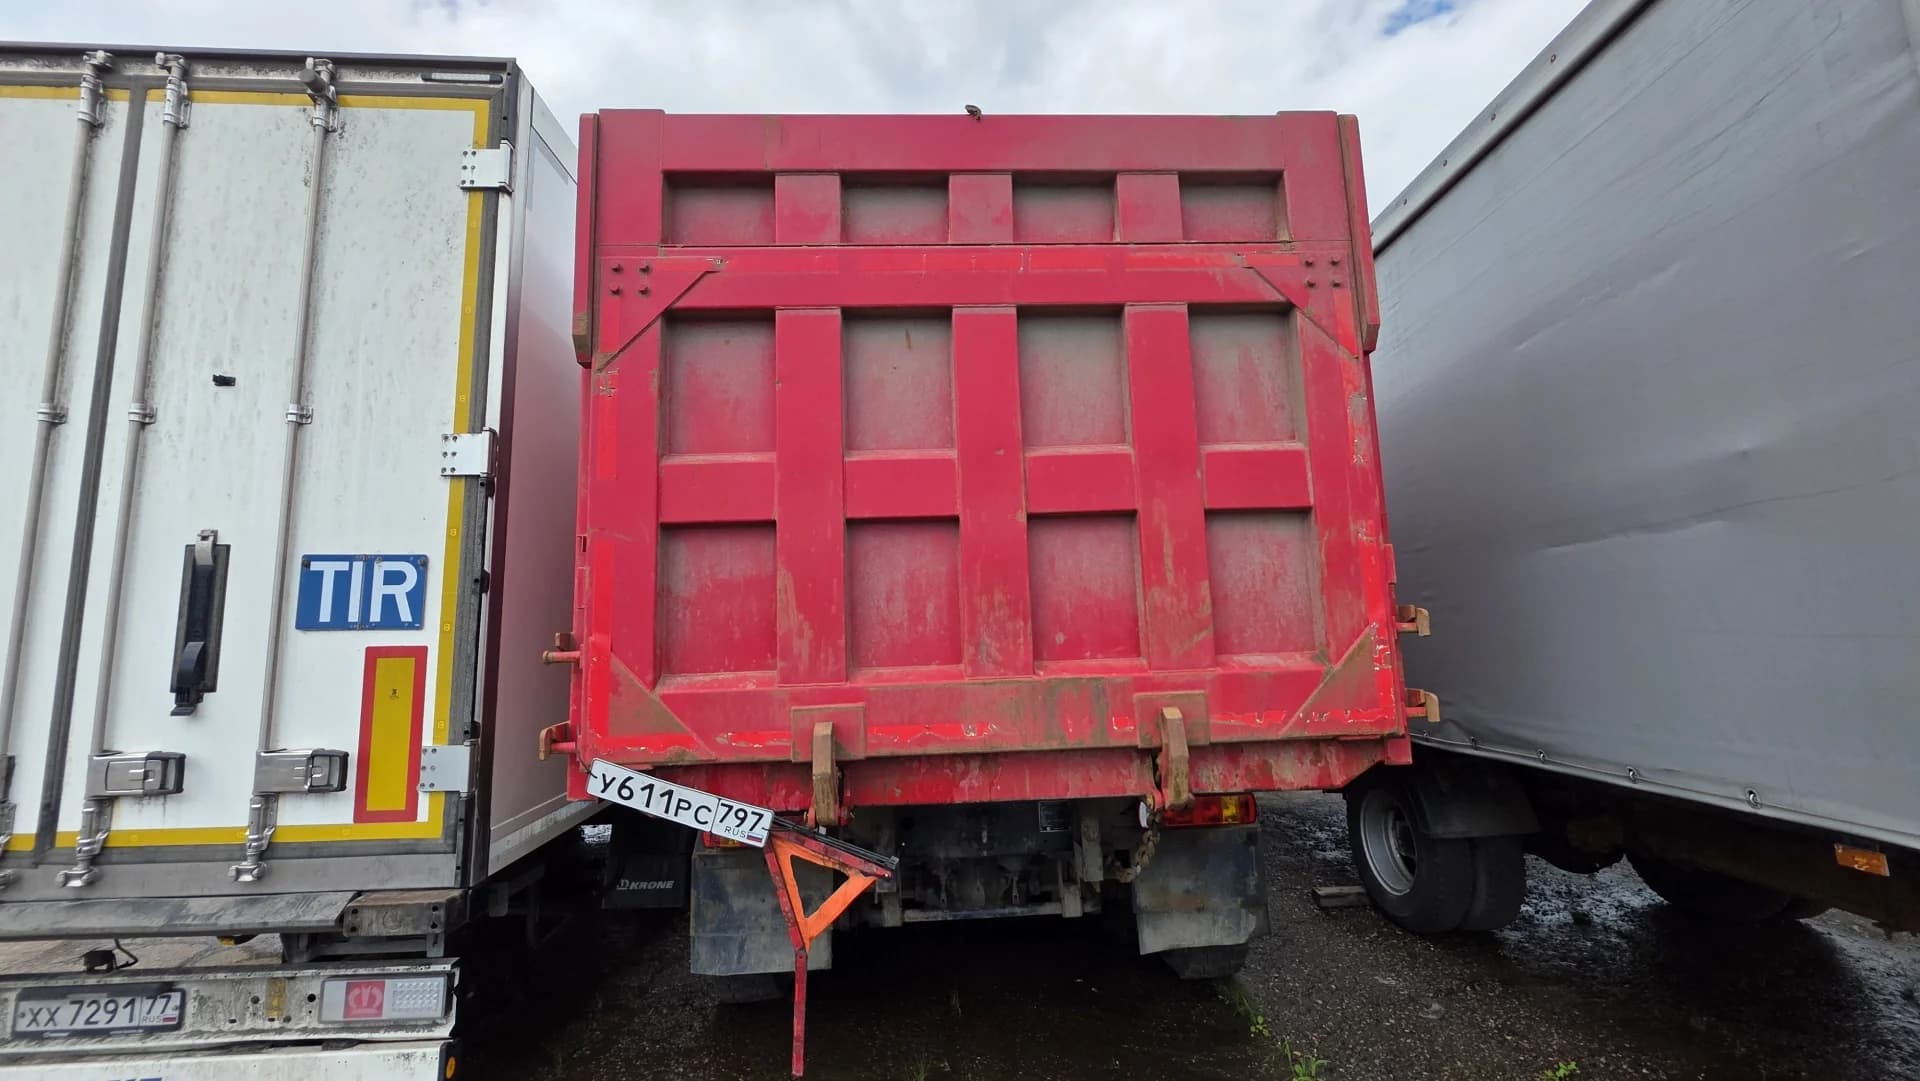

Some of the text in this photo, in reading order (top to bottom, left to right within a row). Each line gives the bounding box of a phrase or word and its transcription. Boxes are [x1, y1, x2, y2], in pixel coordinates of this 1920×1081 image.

[309, 561, 418, 623] TIR
[719, 803, 765, 832] 797
[724, 825, 747, 839] RUS
[629, 880, 675, 890] KRONE
[69, 998, 137, 1026] 7291
[145, 994, 173, 1016] 77
[142, 1016, 161, 1024] RUS
